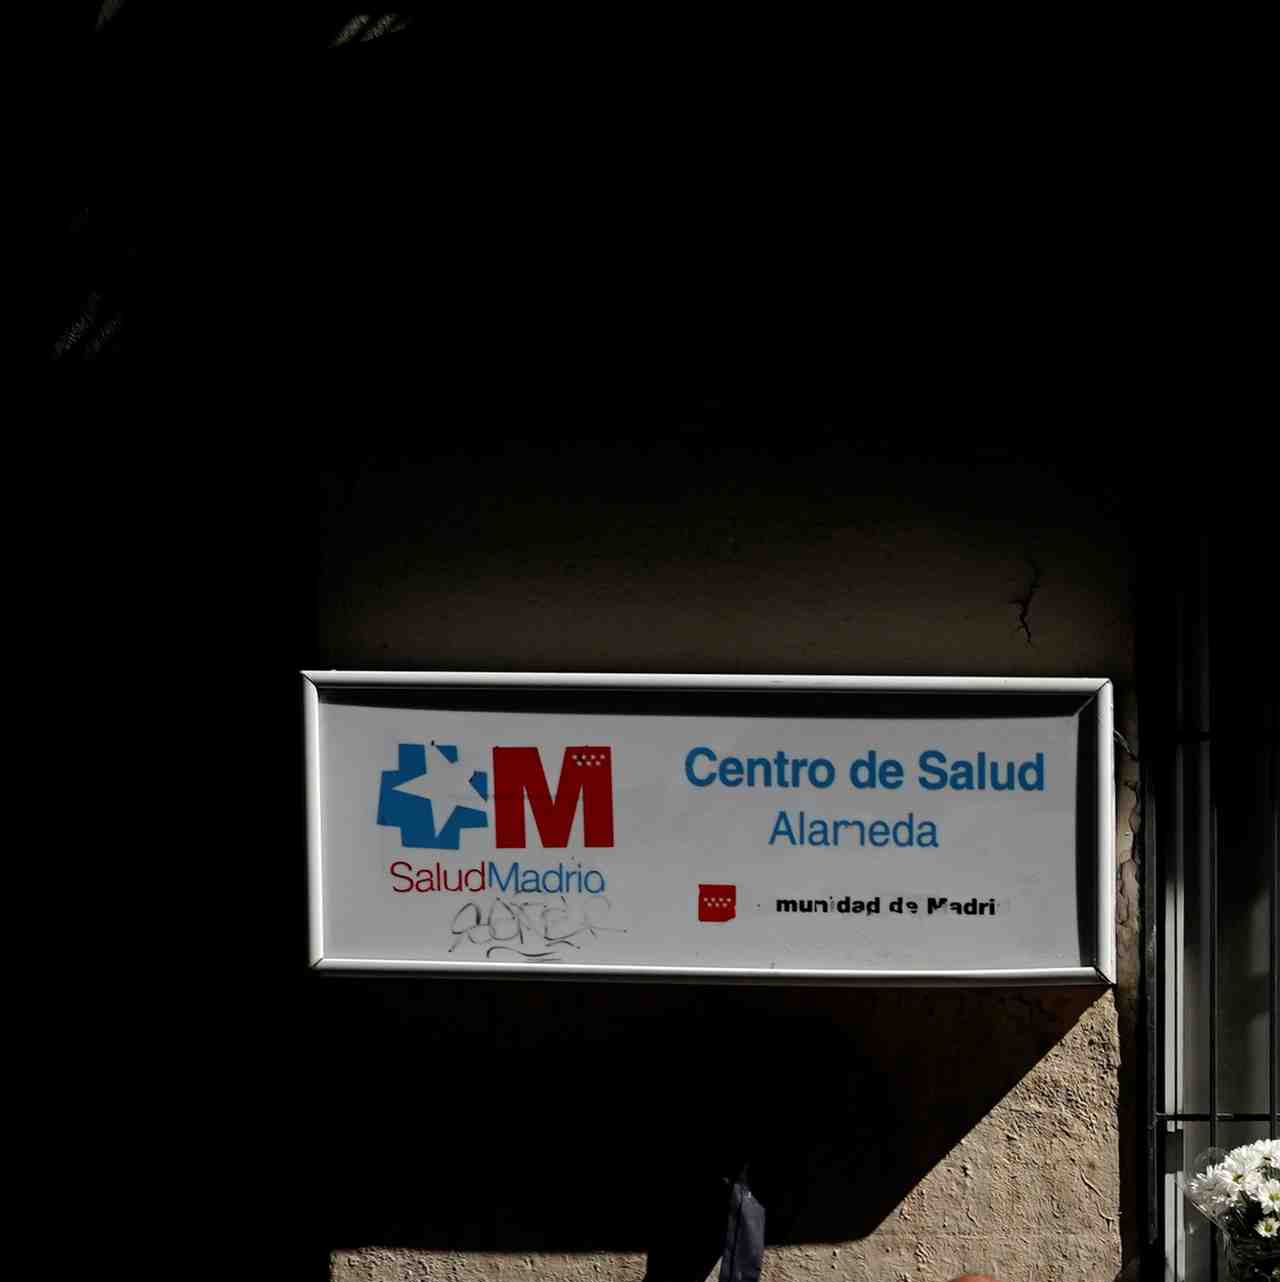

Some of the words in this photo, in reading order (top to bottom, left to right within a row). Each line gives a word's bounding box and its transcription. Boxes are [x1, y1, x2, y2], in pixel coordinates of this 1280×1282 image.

[684, 746, 836, 790] Centro
[848, 749, 905, 790] de
[917, 749, 1045, 792] Salud
[767, 810, 940, 849] Alameda
[888, 896, 919, 915] de
[926, 896, 997, 916] Madri
